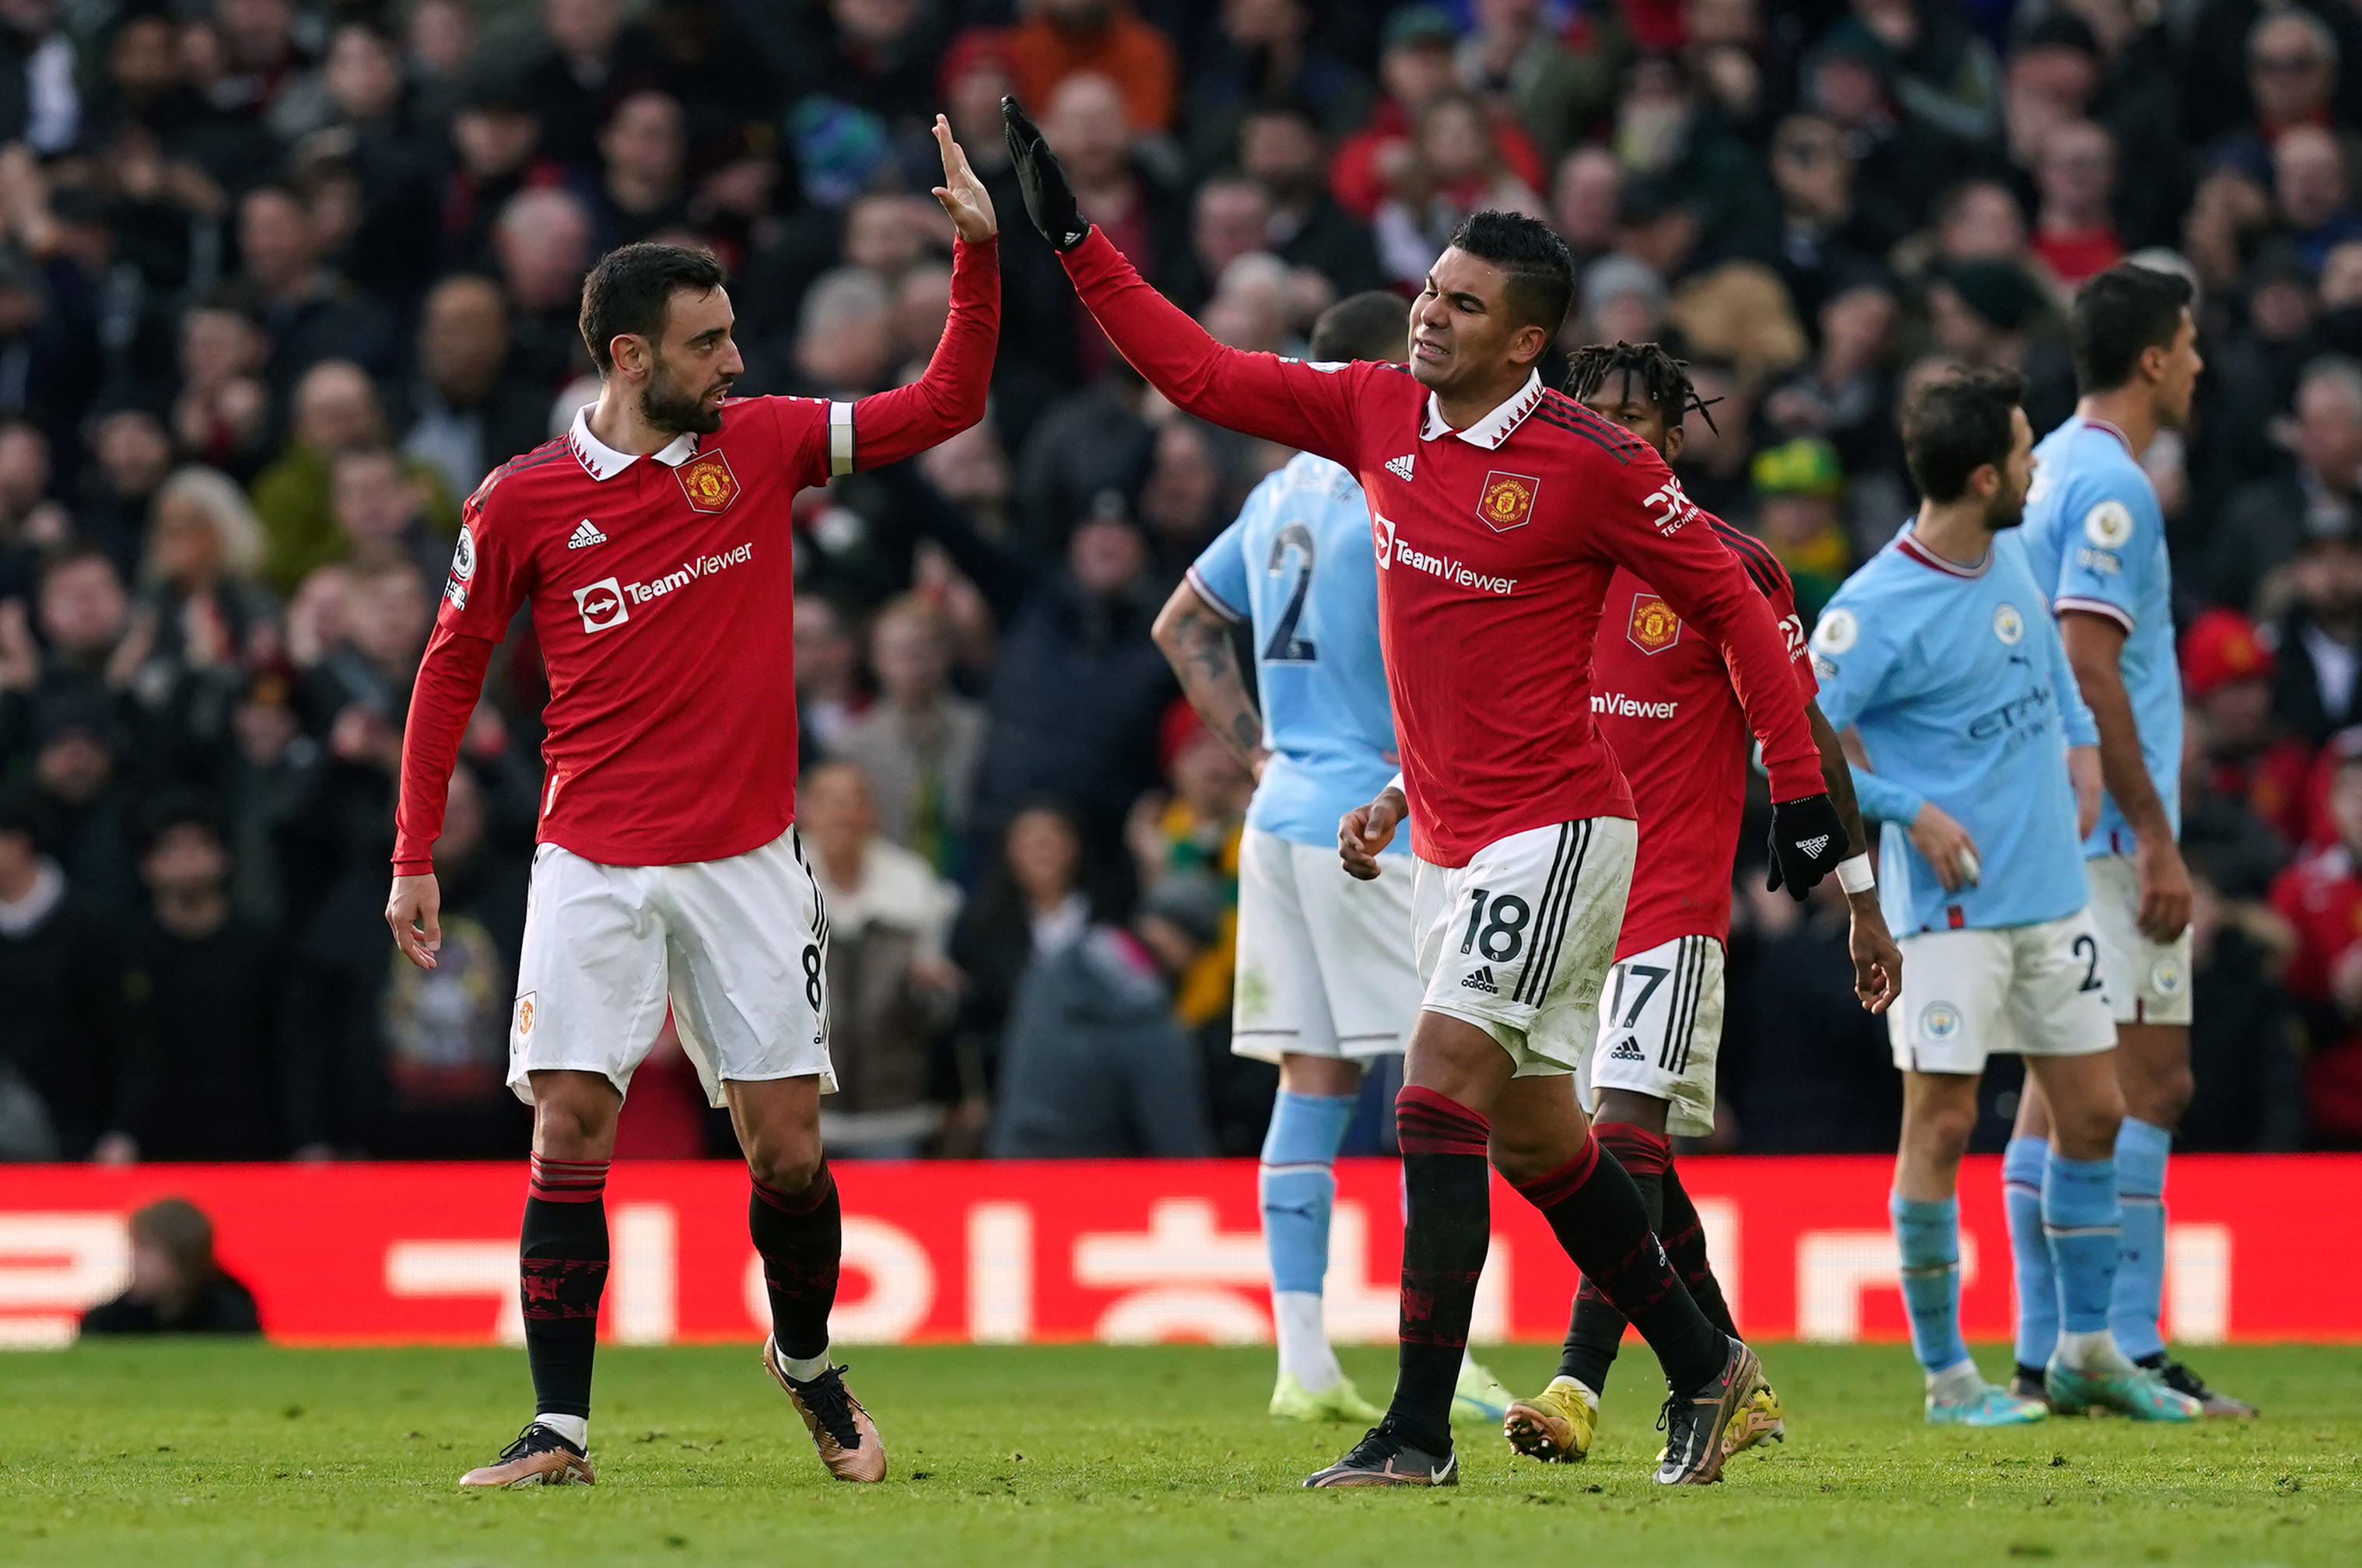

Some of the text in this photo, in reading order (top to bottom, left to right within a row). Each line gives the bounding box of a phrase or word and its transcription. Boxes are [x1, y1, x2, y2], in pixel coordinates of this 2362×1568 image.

[1385, 460, 1414, 482] adidas
[568, 533, 607, 549] adidas
[1395, 538, 1517, 594] TeamViewer
[623, 543, 752, 604] TeamViewer
[1264, 524, 1317, 662] 2
[1589, 691, 1678, 719] mViewer
[1796, 834, 1829, 849] adidas
[1460, 888, 1530, 963] 18
[802, 944, 821, 1013] 8
[1461, 978, 1498, 995] adidas
[2073, 934, 2104, 992] 2
[1609, 964, 1671, 1028] 17
[1611, 1049, 1645, 1062] adidas
